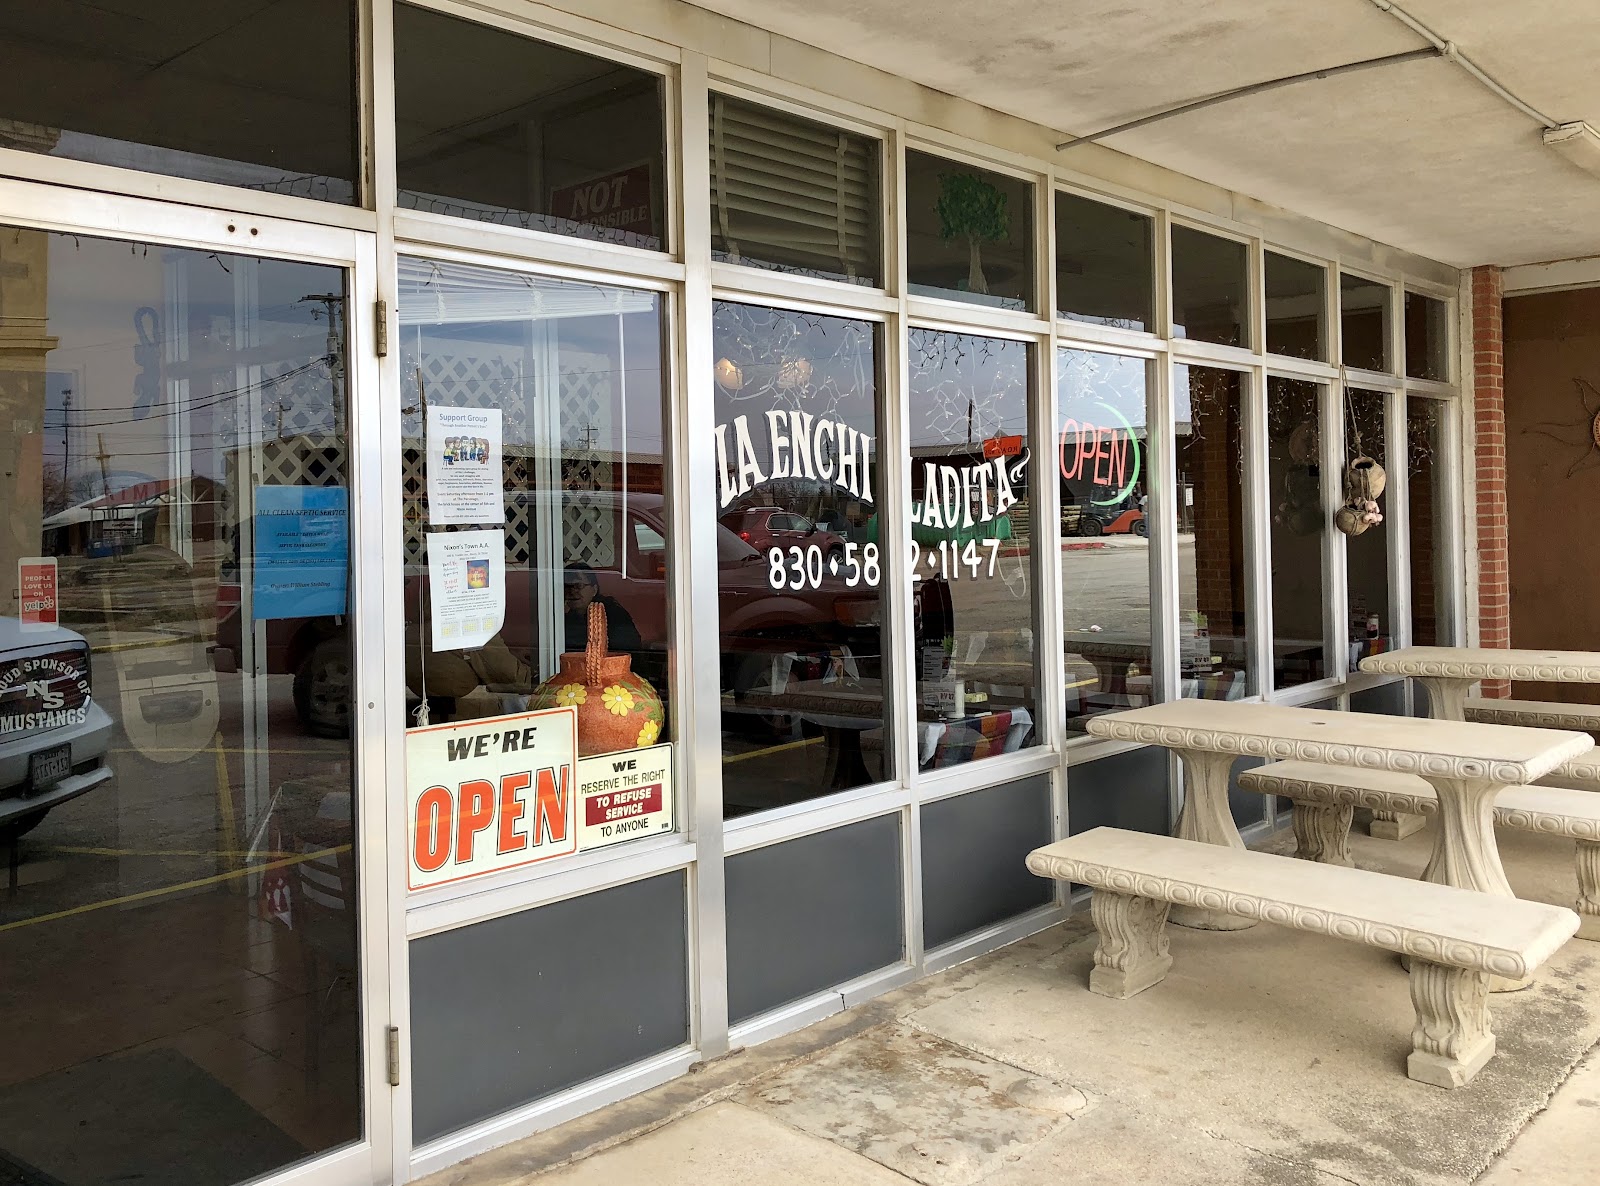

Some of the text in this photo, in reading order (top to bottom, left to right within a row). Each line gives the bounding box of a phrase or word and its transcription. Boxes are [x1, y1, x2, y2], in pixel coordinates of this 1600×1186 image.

[570, 175, 629, 219] NOT
[440, 413, 488, 423] Support Group
[714, 414, 769, 508] LA
[1060, 418, 1128, 488] OPEN
[24, 600, 45, 612] yelp
[24, 658, 80, 680] SPONSOR
[77, 680, 91, 694] OF
[26, 680, 64, 709] NS
[0, 708, 86, 732] MUSTANGS
[447, 726, 538, 762] WE'RE
[612, 760, 637, 772] WE
[581, 769, 665, 794] RESERVE THE RIGHT
[596, 788, 652, 809] TO REFUSE
[413, 764, 570, 872] OPEN
[605, 804, 643, 820] SERVICE
[601, 818, 649, 837] TO ANYONE
